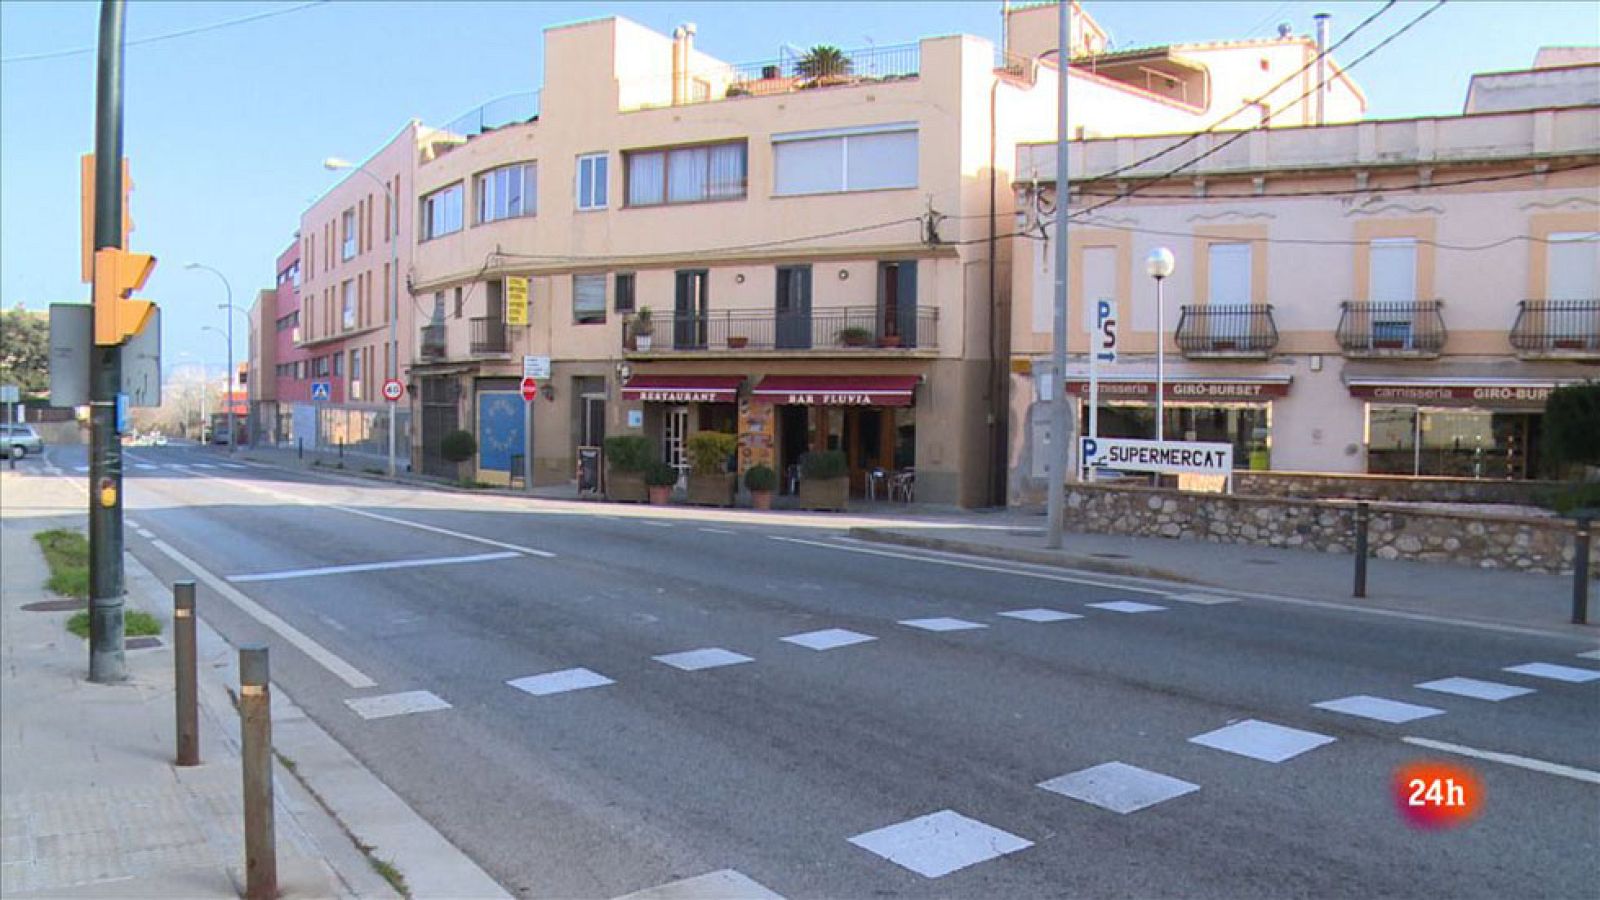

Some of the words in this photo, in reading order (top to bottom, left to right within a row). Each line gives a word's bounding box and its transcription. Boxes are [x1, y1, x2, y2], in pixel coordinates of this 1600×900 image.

[1097, 301, 1110, 329] P
[1103, 320, 1115, 348] S
[640, 391, 717, 402] RESTAURANT
[1081, 384, 1148, 394] crnisseria
[788, 394, 814, 405] BAR
[1082, 438, 1098, 465] P
[1109, 445, 1226, 469] SUPERMERCAT
